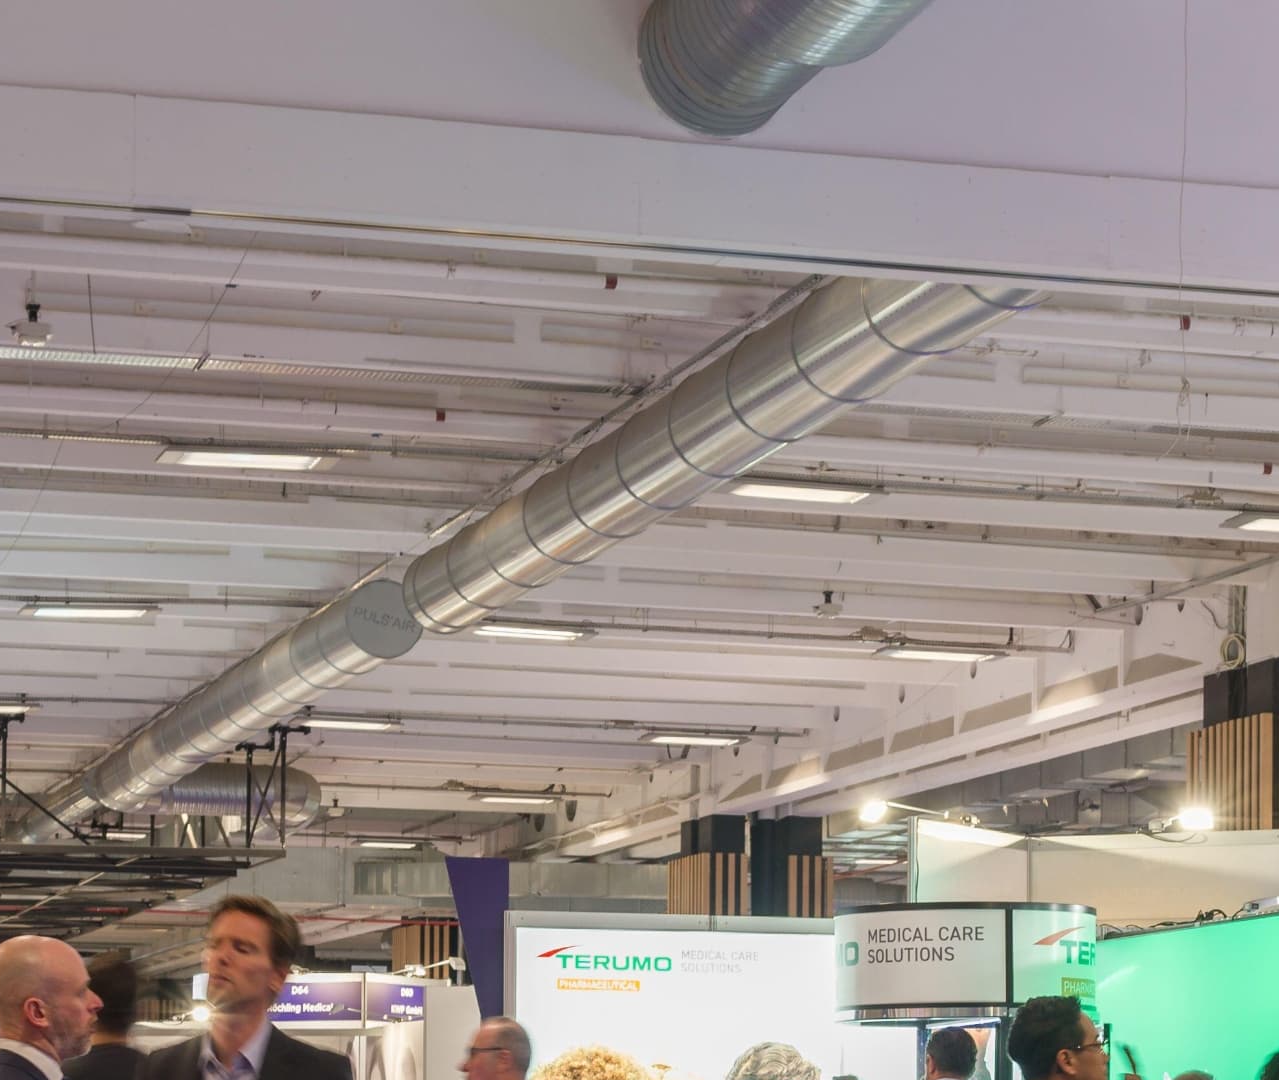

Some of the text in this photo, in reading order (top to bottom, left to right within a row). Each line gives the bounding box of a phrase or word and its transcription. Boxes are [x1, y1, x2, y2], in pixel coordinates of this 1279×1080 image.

[868, 926, 984, 944] MEDICAL CARE
[555, 953, 672, 972] TERUMO
[681, 950, 759, 962] MEDICAL CARE
[868, 946, 955, 965] SOLUTIONS
[681, 962, 742, 974] SOLUTIONS
